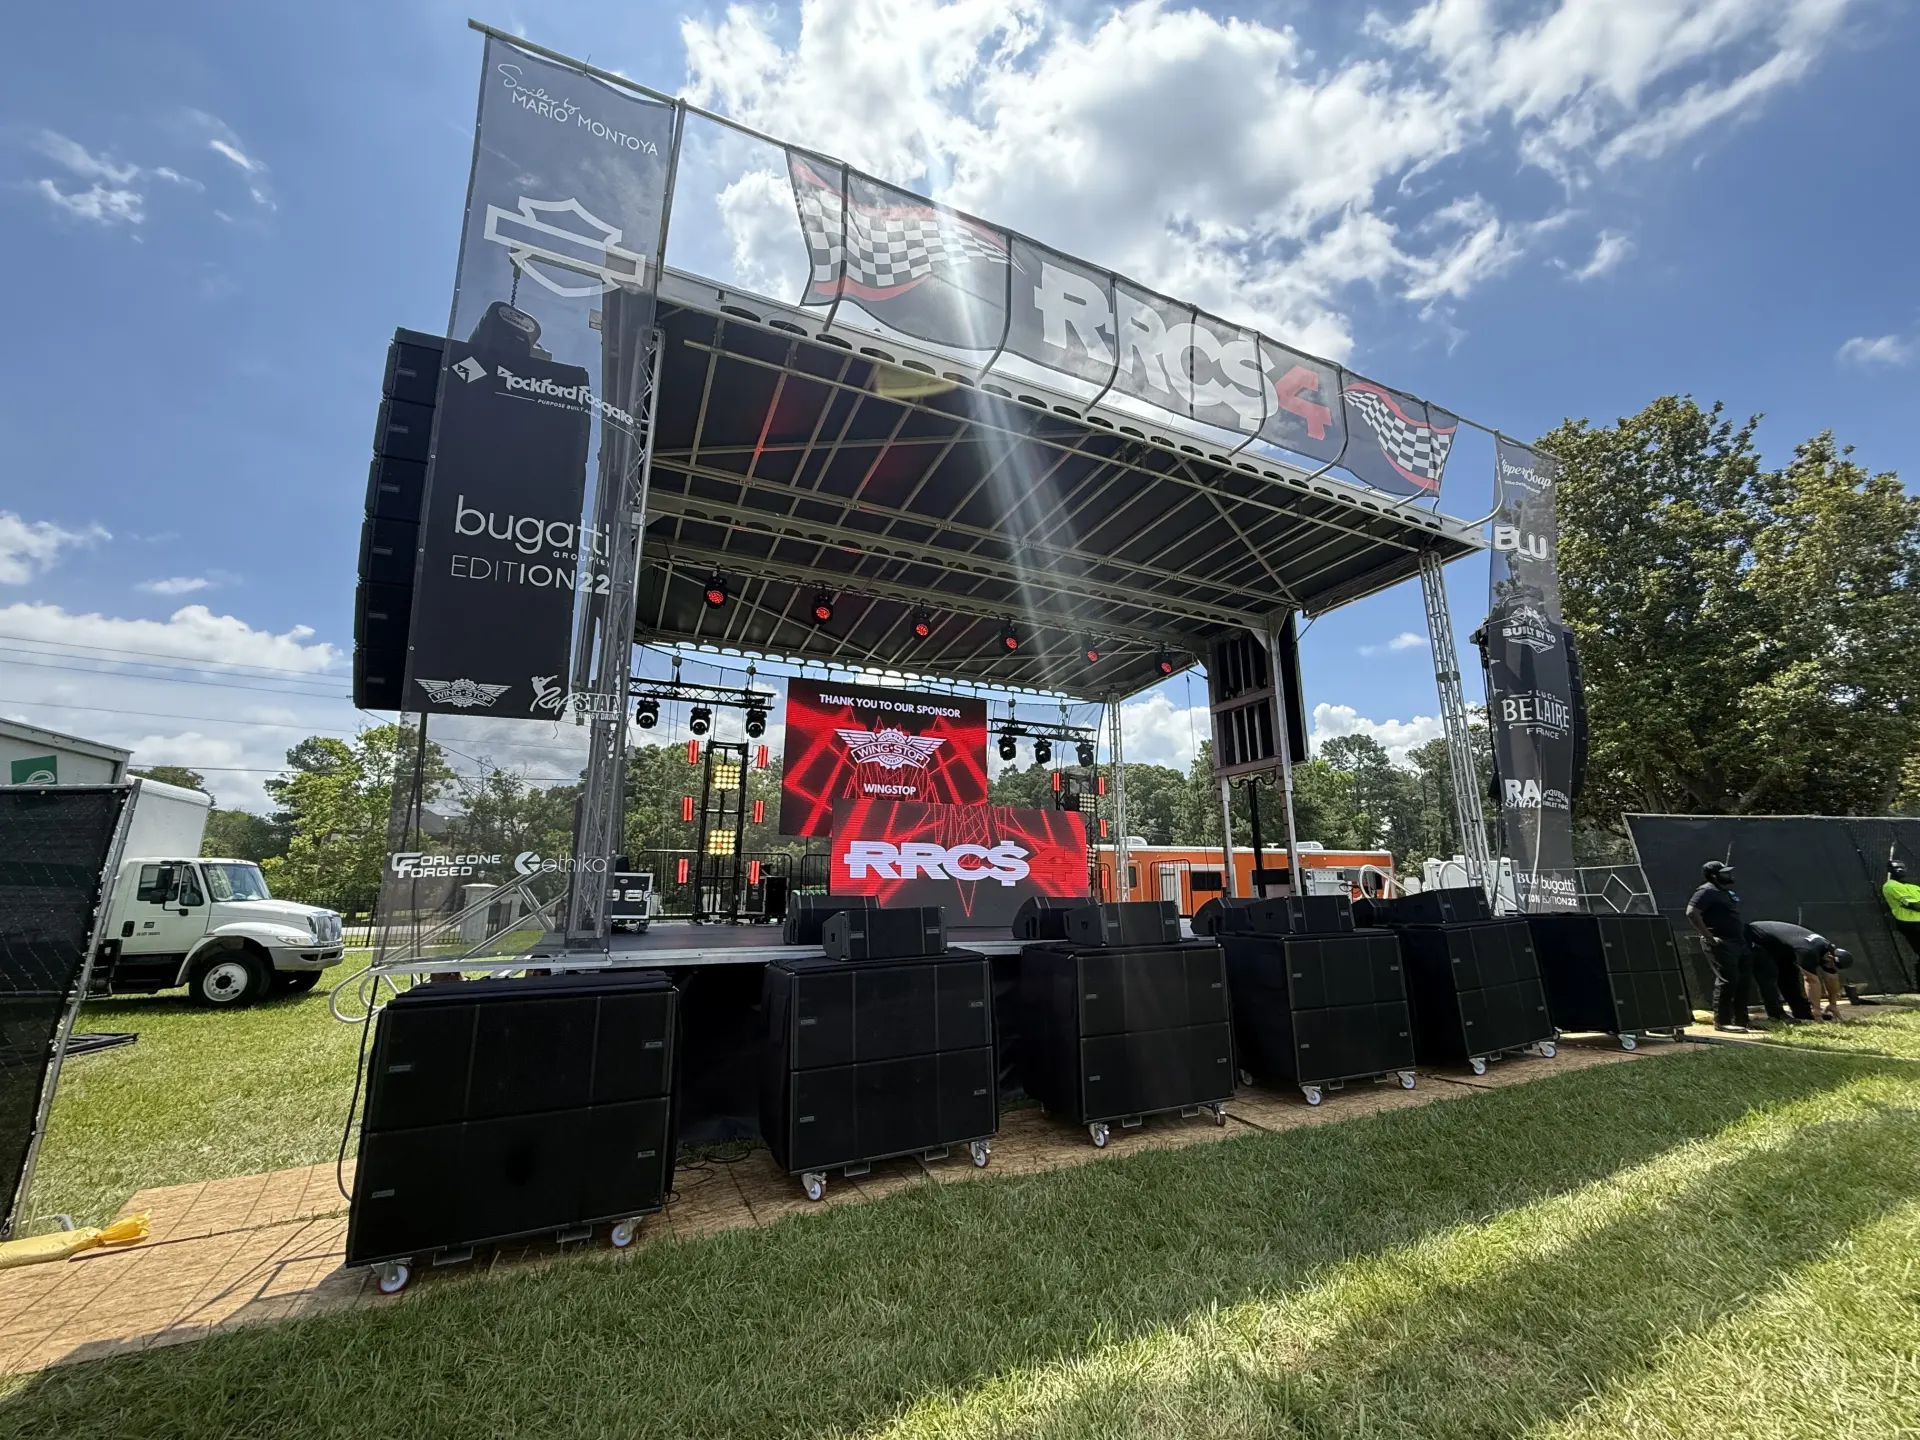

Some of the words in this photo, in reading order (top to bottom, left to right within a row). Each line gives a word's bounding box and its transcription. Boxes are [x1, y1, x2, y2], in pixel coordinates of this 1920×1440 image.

[498, 64, 559, 105] Smiles
[564, 98, 580, 114] by
[512, 91, 568, 122] MARIO
[578, 113, 658, 156] MONTOYA
[497, 365, 577, 400] Rockford
[578, 386, 634, 425] Fosgate
[537, 399, 565, 409] PURPOSE
[1276, 365, 1332, 441] 4
[455, 495, 610, 557] bugatti
[1494, 525, 1547, 560] BLU
[1503, 626, 1534, 636] BUILT
[1536, 630, 1544, 639] BY
[820, 694, 854, 706] THANK
[856, 698, 877, 709] YOU
[879, 701, 892, 710] TO
[894, 703, 914, 713] OUR
[917, 705, 960, 718] SPONSOR
[1501, 698, 1569, 729] BELAIRE
[1527, 728, 1559, 739] FRANCE
[864, 783, 917, 796] WINGSTOP
[541, 853, 608, 873] ethika
[1541, 874, 1576, 894] bugatti
